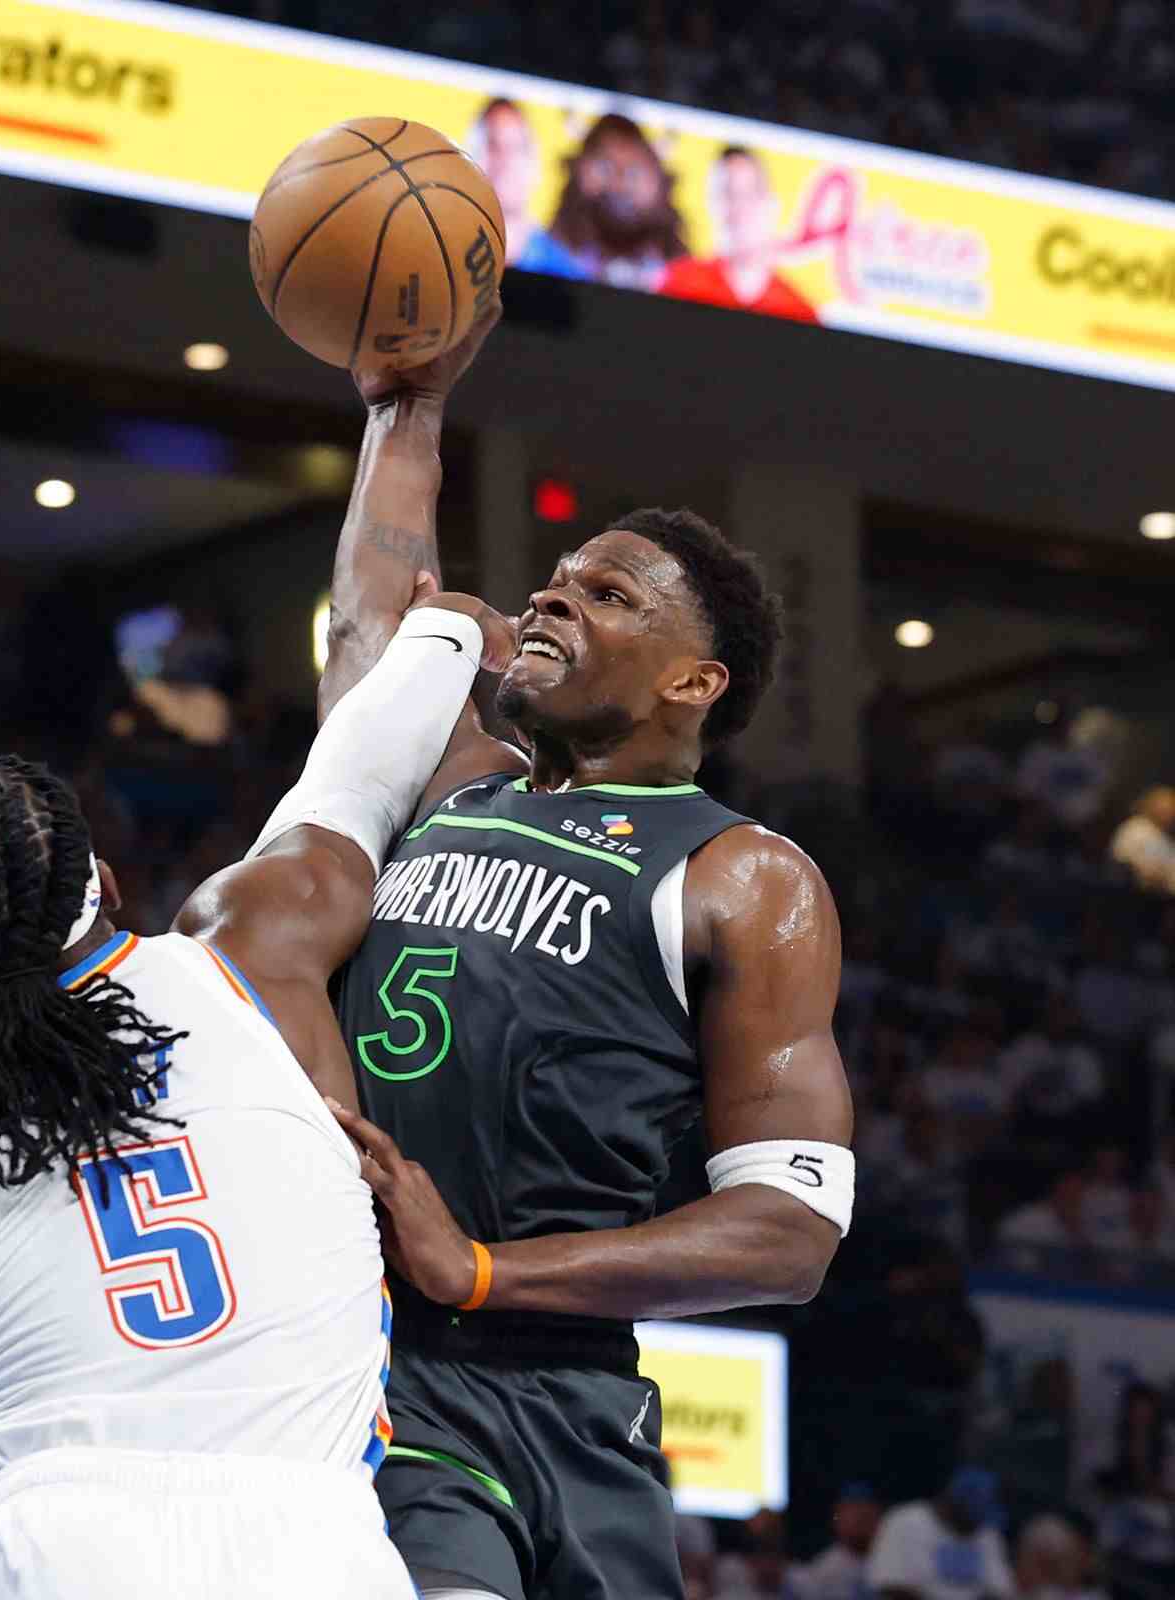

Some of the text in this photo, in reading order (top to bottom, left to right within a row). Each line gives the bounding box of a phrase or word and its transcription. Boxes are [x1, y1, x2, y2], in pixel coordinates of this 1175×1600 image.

[560, 819, 642, 855] sezzle
[372, 852, 611, 966] MBERWOLVES
[357, 946, 458, 1081] 5
[789, 1152, 824, 1188] 5
[74, 1135, 237, 1352] 5
